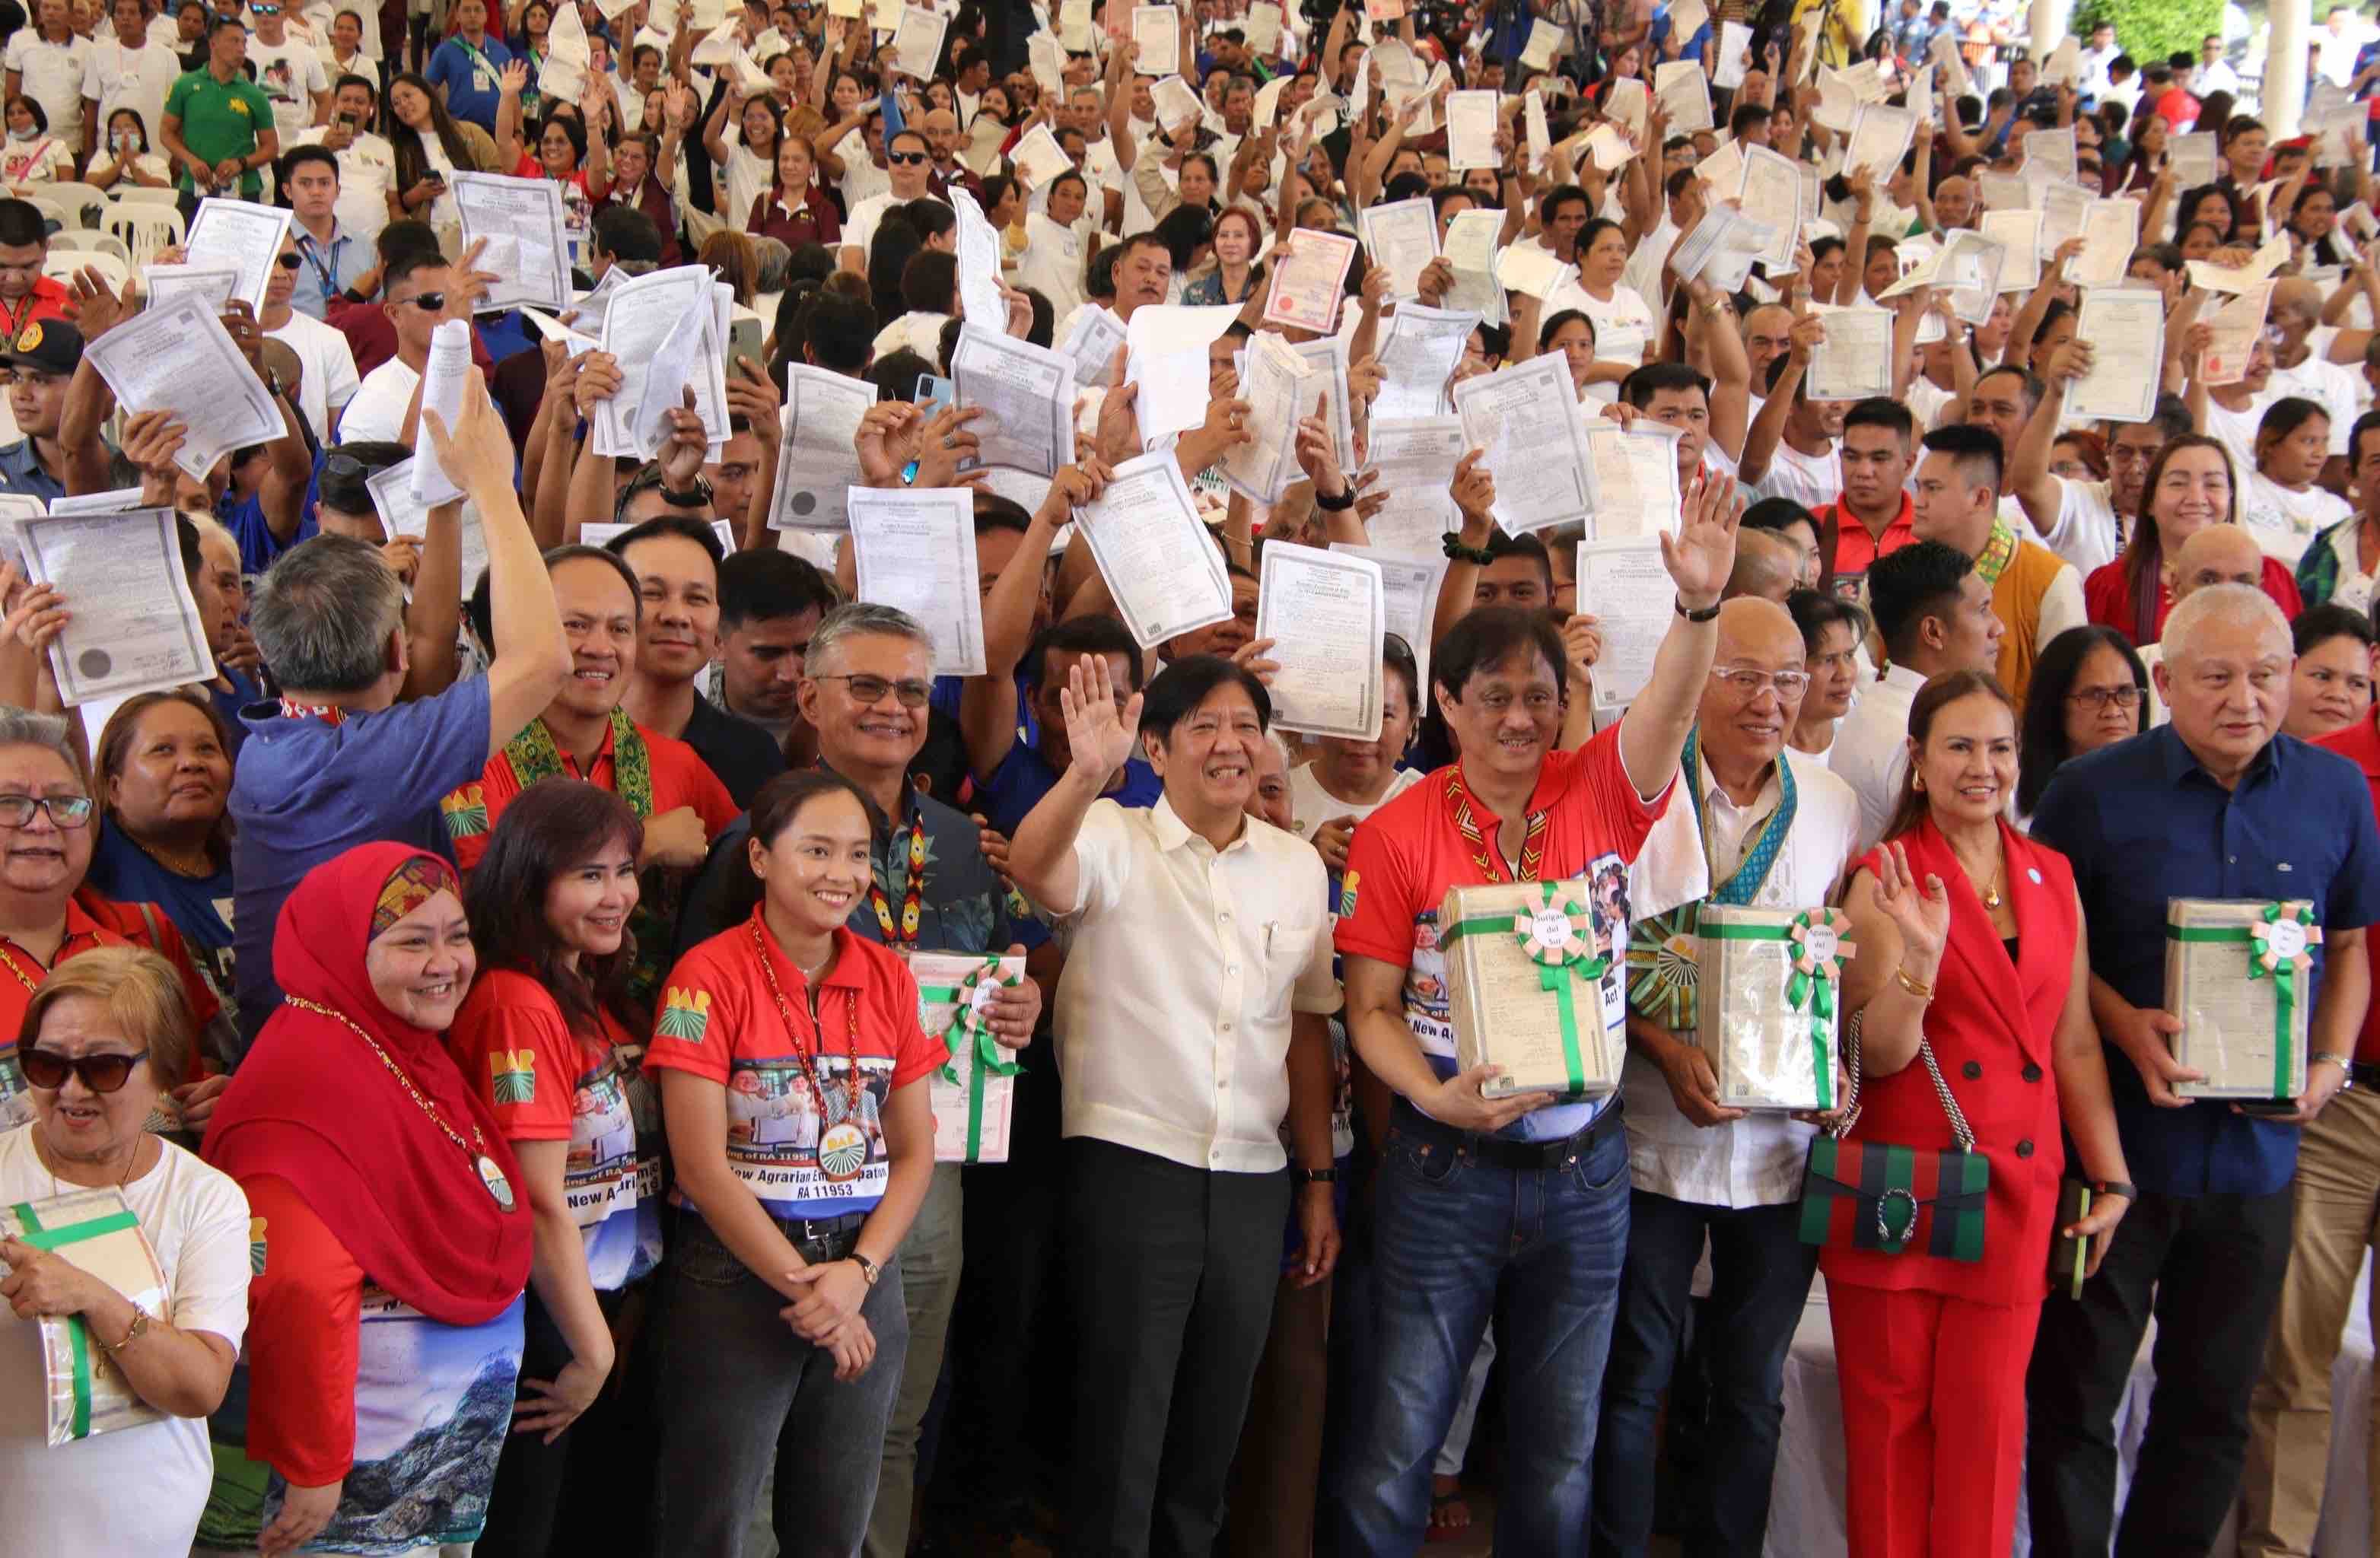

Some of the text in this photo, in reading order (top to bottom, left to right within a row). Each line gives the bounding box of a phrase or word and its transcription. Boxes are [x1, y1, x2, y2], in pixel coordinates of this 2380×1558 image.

[1413, 1019, 1437, 1036] New
[731, 1166, 753, 1180] ew
[758, 1167, 811, 1184] Agrarian
[566, 1191, 602, 1210] New
[797, 1184, 853, 1200] RA 11953
